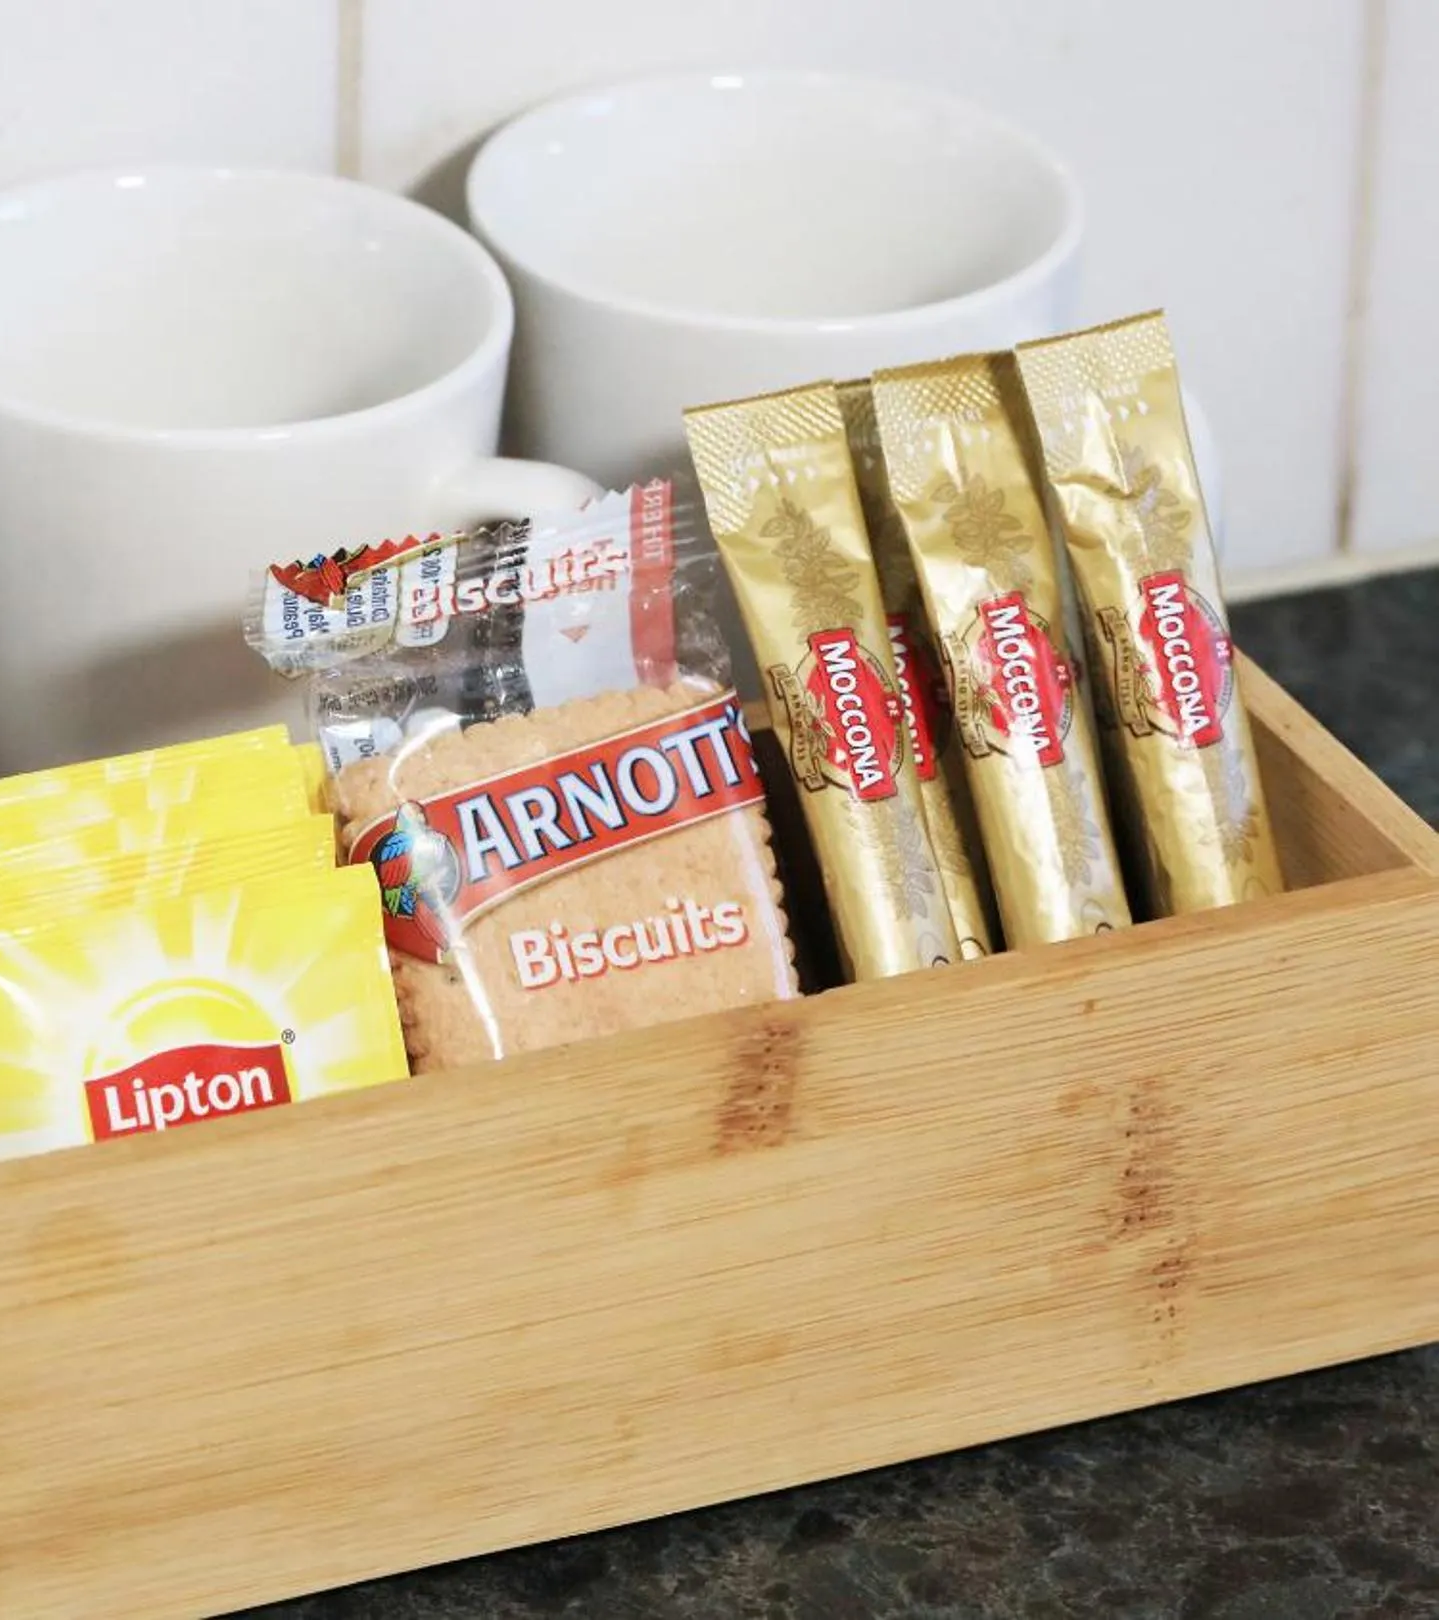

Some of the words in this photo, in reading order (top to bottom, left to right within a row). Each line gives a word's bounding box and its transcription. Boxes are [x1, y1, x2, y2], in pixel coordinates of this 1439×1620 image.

[819, 640, 885, 791] MOCCONA
[987, 604, 1052, 756] MOCCONA
[1148, 582, 1210, 738] MOCCONA
[509, 895, 750, 990] Biscuits
[104, 1065, 274, 1132] Lipton
